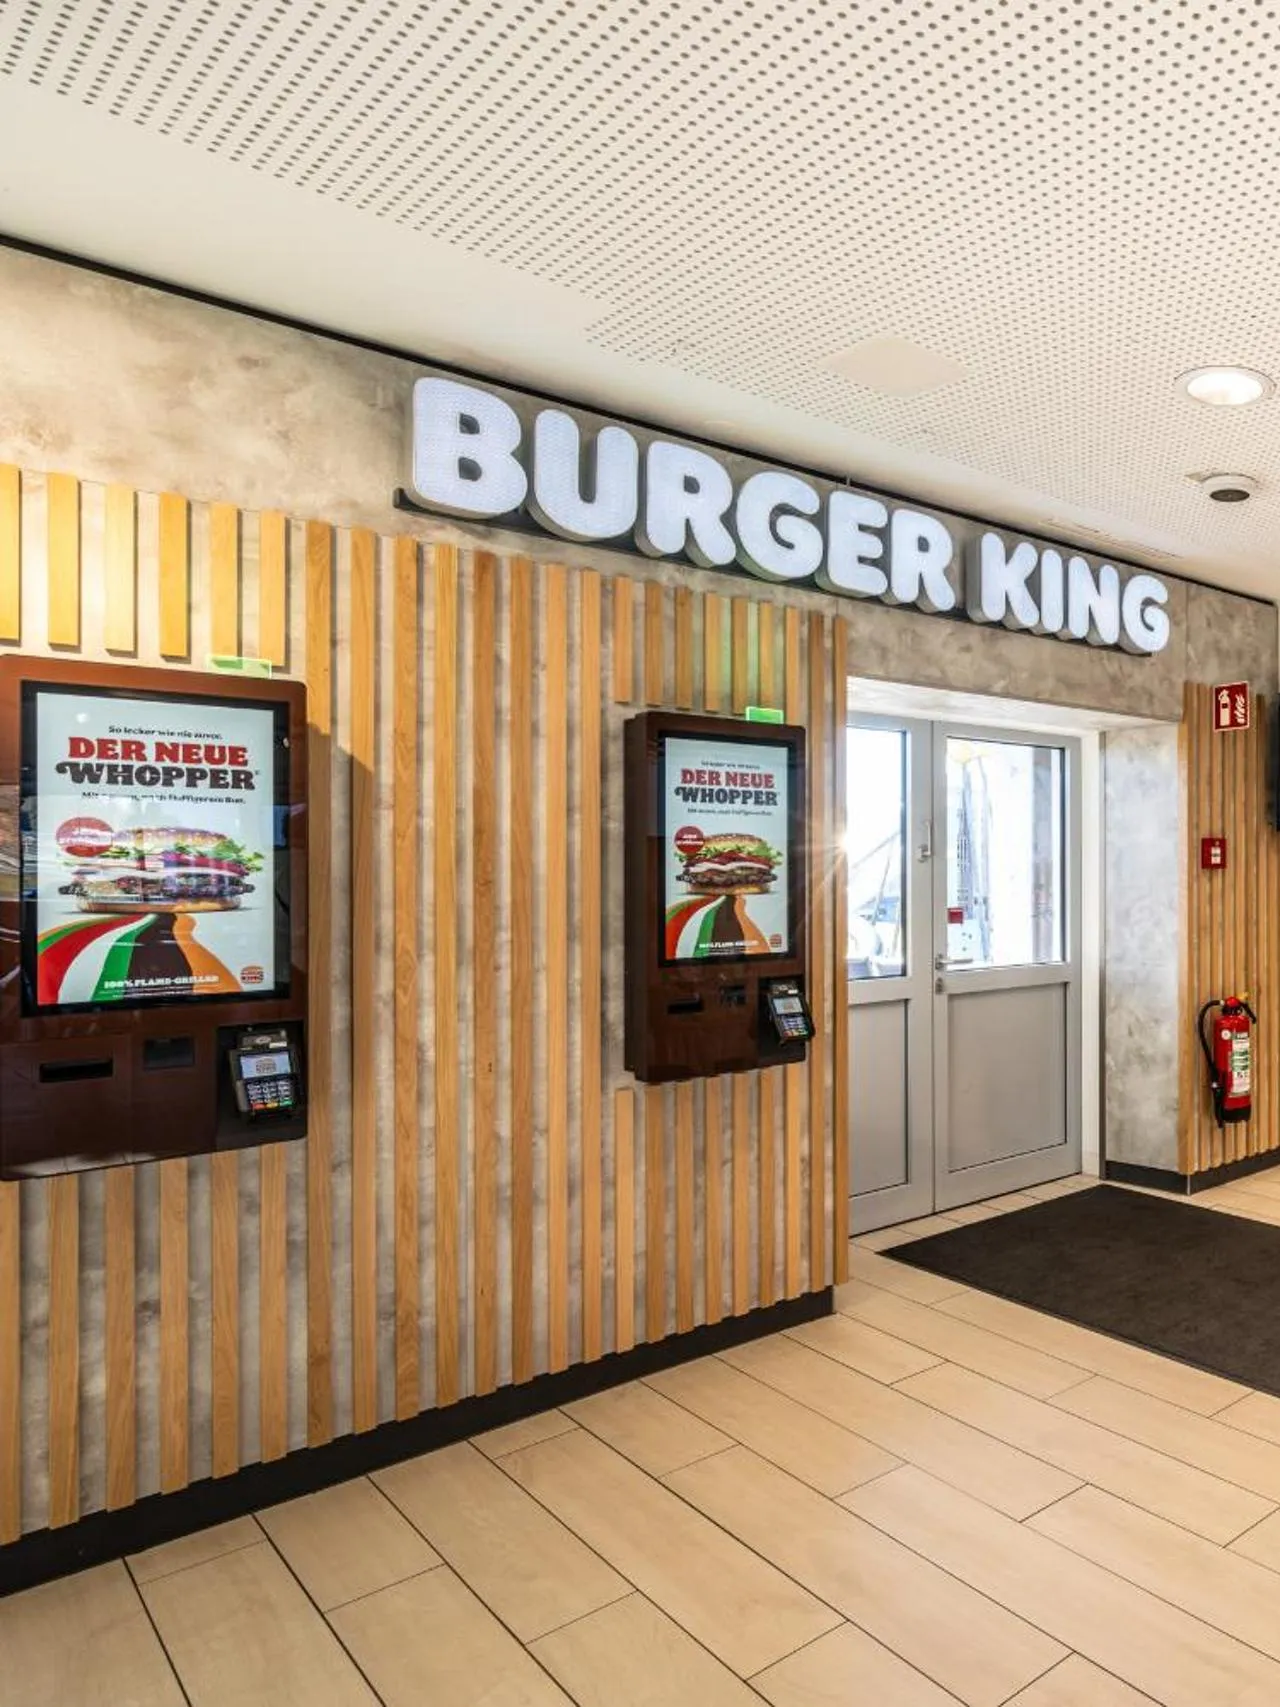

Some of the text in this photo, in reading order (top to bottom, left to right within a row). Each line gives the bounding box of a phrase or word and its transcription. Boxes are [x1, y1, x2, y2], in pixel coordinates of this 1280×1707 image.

[411, 376, 1171, 655] BURGER KING
[68, 736, 249, 767] DER NEUE
[55, 762, 256, 791] WHOPPER
[681, 768, 775, 789] DER NEUE
[674, 786, 778, 806] WHOPPER
[103, 979, 133, 989] 100%
